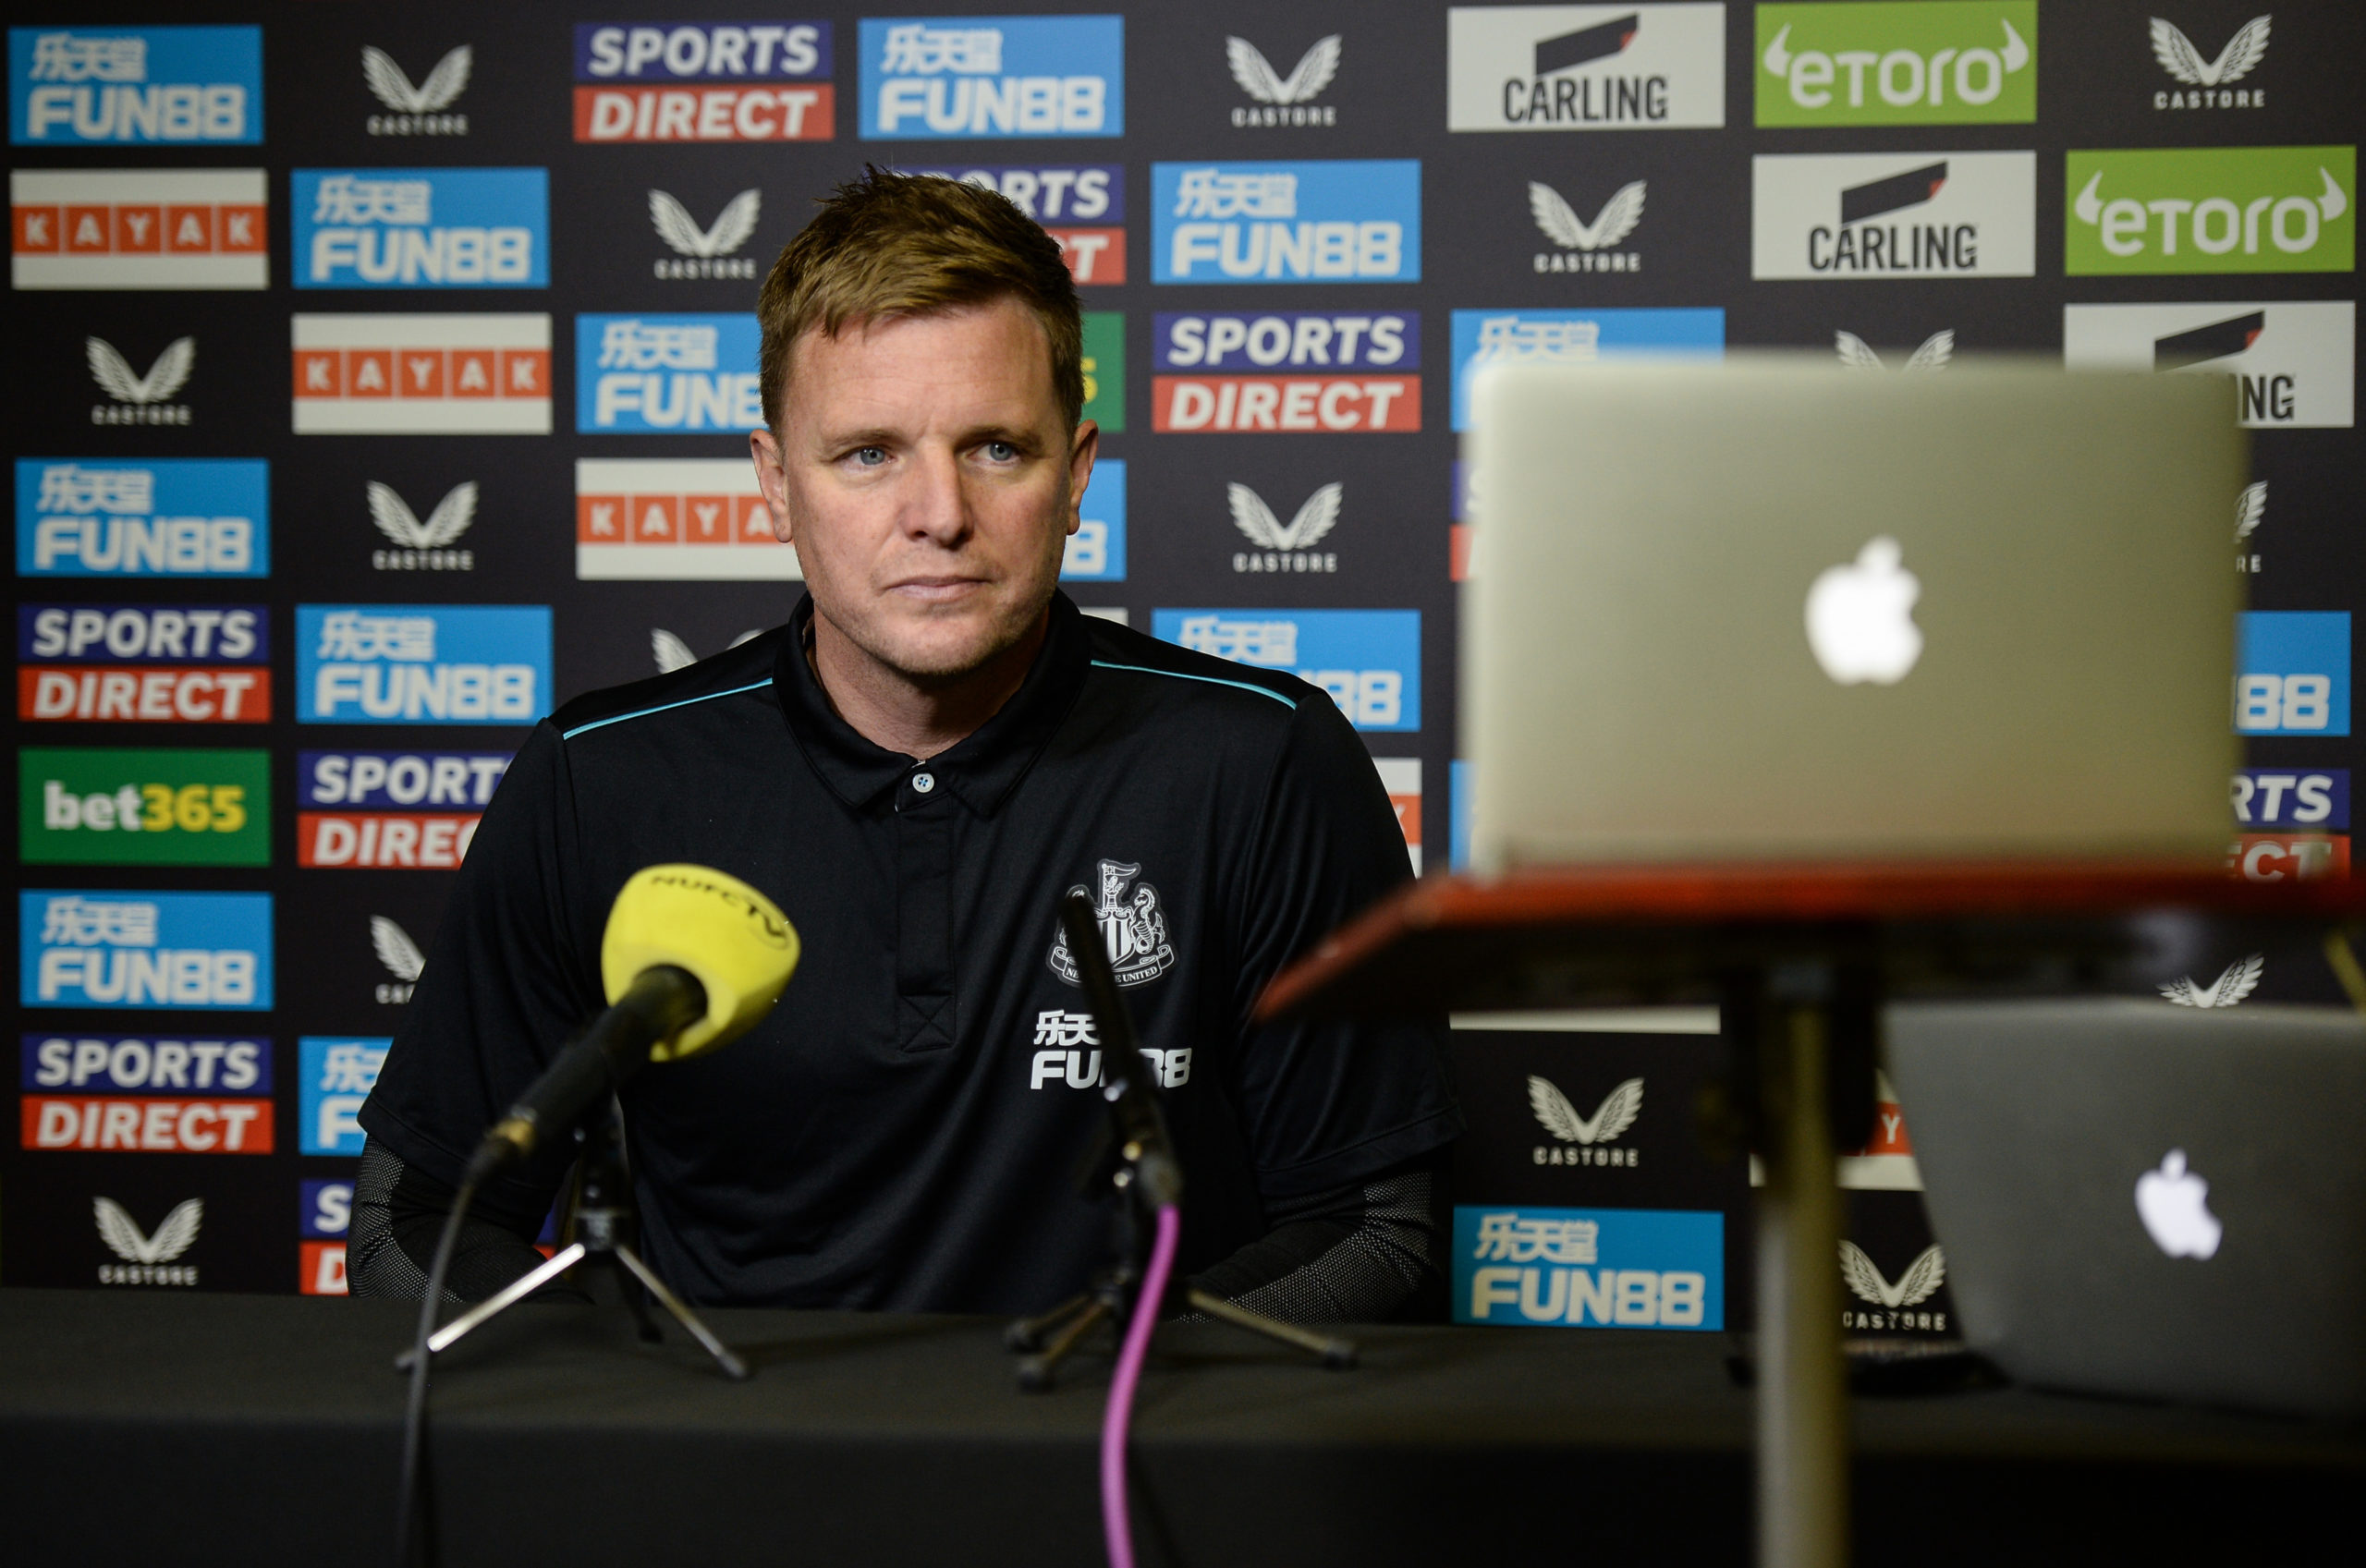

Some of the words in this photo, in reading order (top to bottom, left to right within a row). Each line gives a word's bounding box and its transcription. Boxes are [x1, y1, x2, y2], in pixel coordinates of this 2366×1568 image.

[590, 25, 818, 76] SPORTS
[27, 84, 247, 140] FUN88
[590, 90, 819, 139] DIRECT
[878, 76, 1106, 134] FUN88
[1231, 106, 1335, 127] CASTORE
[1503, 75, 1668, 124] CARLING
[2153, 89, 2264, 110] CASTORE
[367, 114, 468, 135] CASTORE
[25, 213, 253, 246] KAYAK
[1170, 221, 1402, 278] FUN88
[1809, 225, 1977, 271] CARLING
[311, 226, 533, 284] FUN88
[653, 258, 756, 279] CASTORE
[1533, 252, 1640, 273] CASTORE
[1167, 316, 1405, 366] SPORTS
[307, 357, 536, 391] KAYAK
[91, 405, 190, 425] CASTORE
[596, 371, 766, 428] FUN8
[1168, 381, 1405, 430] DIRECT
[590, 502, 774, 536] KAYA
[34, 516, 253, 573] FUN88
[372, 550, 472, 571] CASTORE
[1233, 553, 1336, 573] CASTORE
[33, 609, 256, 659] SPORTS
[34, 672, 256, 721] DIRECT
[314, 662, 536, 720] FUN88
[312, 754, 515, 805] SPORT
[2229, 774, 2334, 823] RTS
[44, 781, 247, 833] bet365
[313, 818, 481, 867] DIRE
[38, 947, 258, 1005] FUN88
[1122, 966, 1158, 982] UNITED
[1033, 1009, 1102, 1047] 乐天
[36, 1039, 259, 1089] SPORTS
[37, 1101, 259, 1150] DIRECT
[1533, 1147, 1638, 1167] CASTORE
[99, 1265, 197, 1285] CASTORE
[1471, 1266, 1706, 1327] FUN88
[1843, 1311, 1945, 1331] CASTORE
